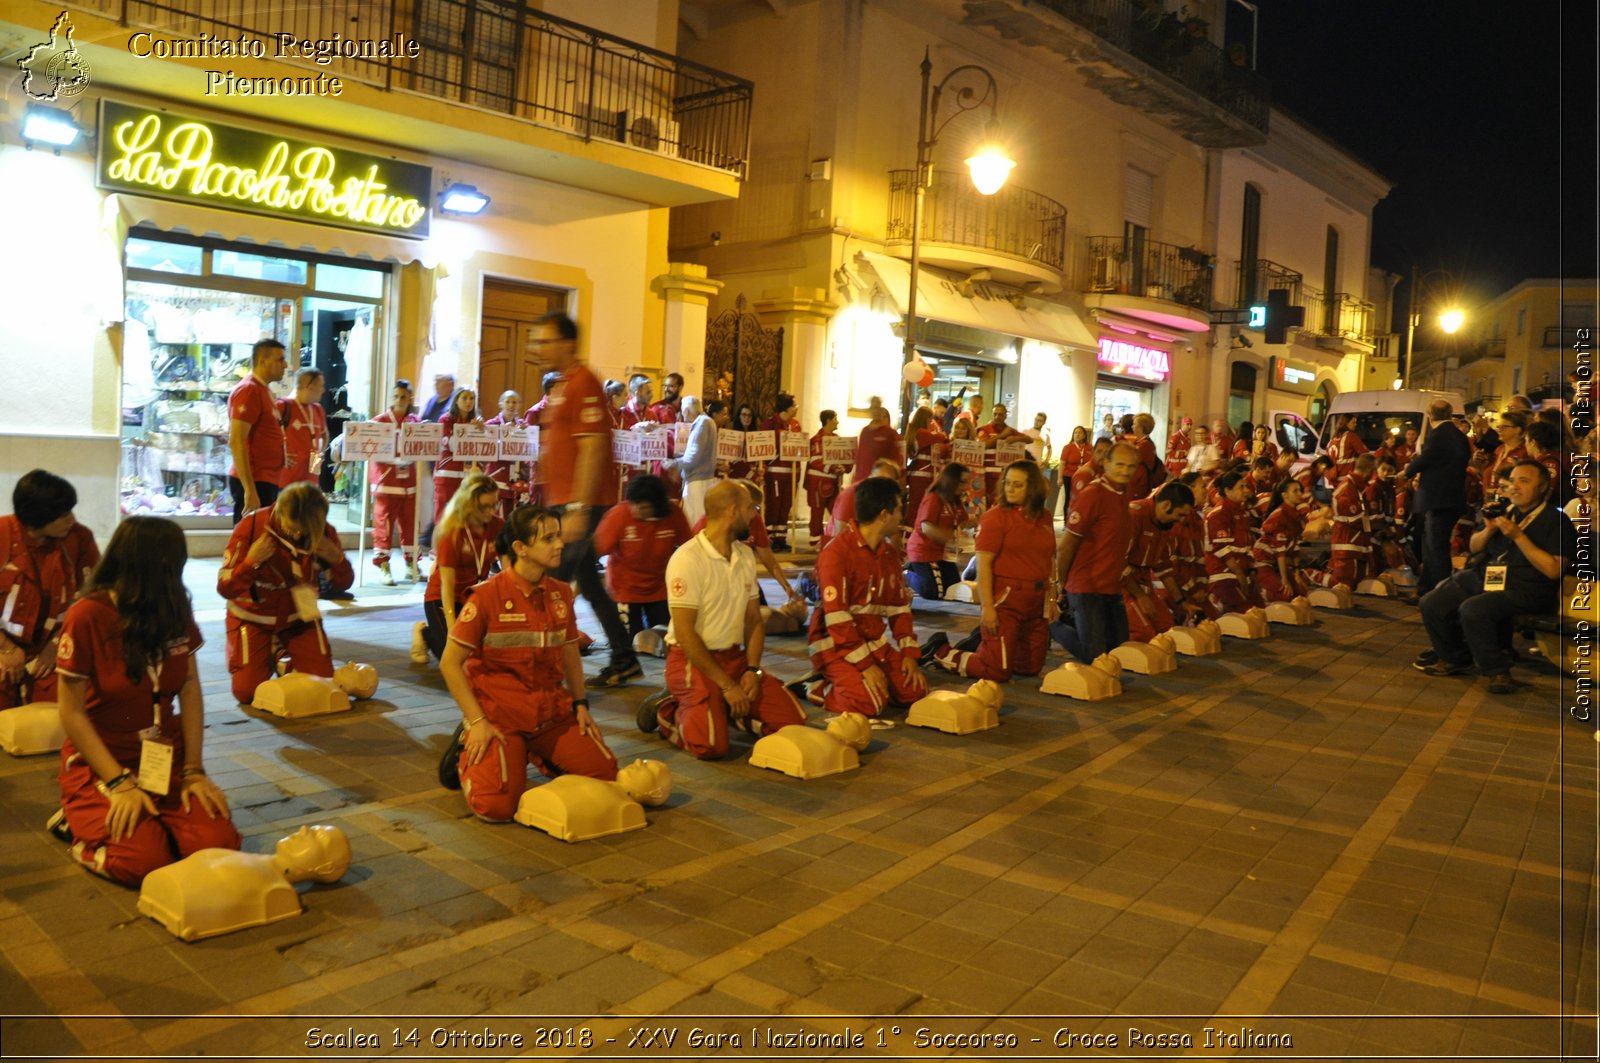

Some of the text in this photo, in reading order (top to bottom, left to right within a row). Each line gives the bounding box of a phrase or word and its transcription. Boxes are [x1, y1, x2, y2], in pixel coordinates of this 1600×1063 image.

[107, 114, 165, 185] La
[289, 146, 426, 229] Positano
[403, 440, 440, 456] CAMPANIA
[456, 441, 496, 456] ABRUZZO
[641, 440, 666, 449] MILIA
[749, 444, 774, 457] LAZIO
[782, 446, 809, 457] MARCHE
[955, 451, 982, 465] PUGLIA
